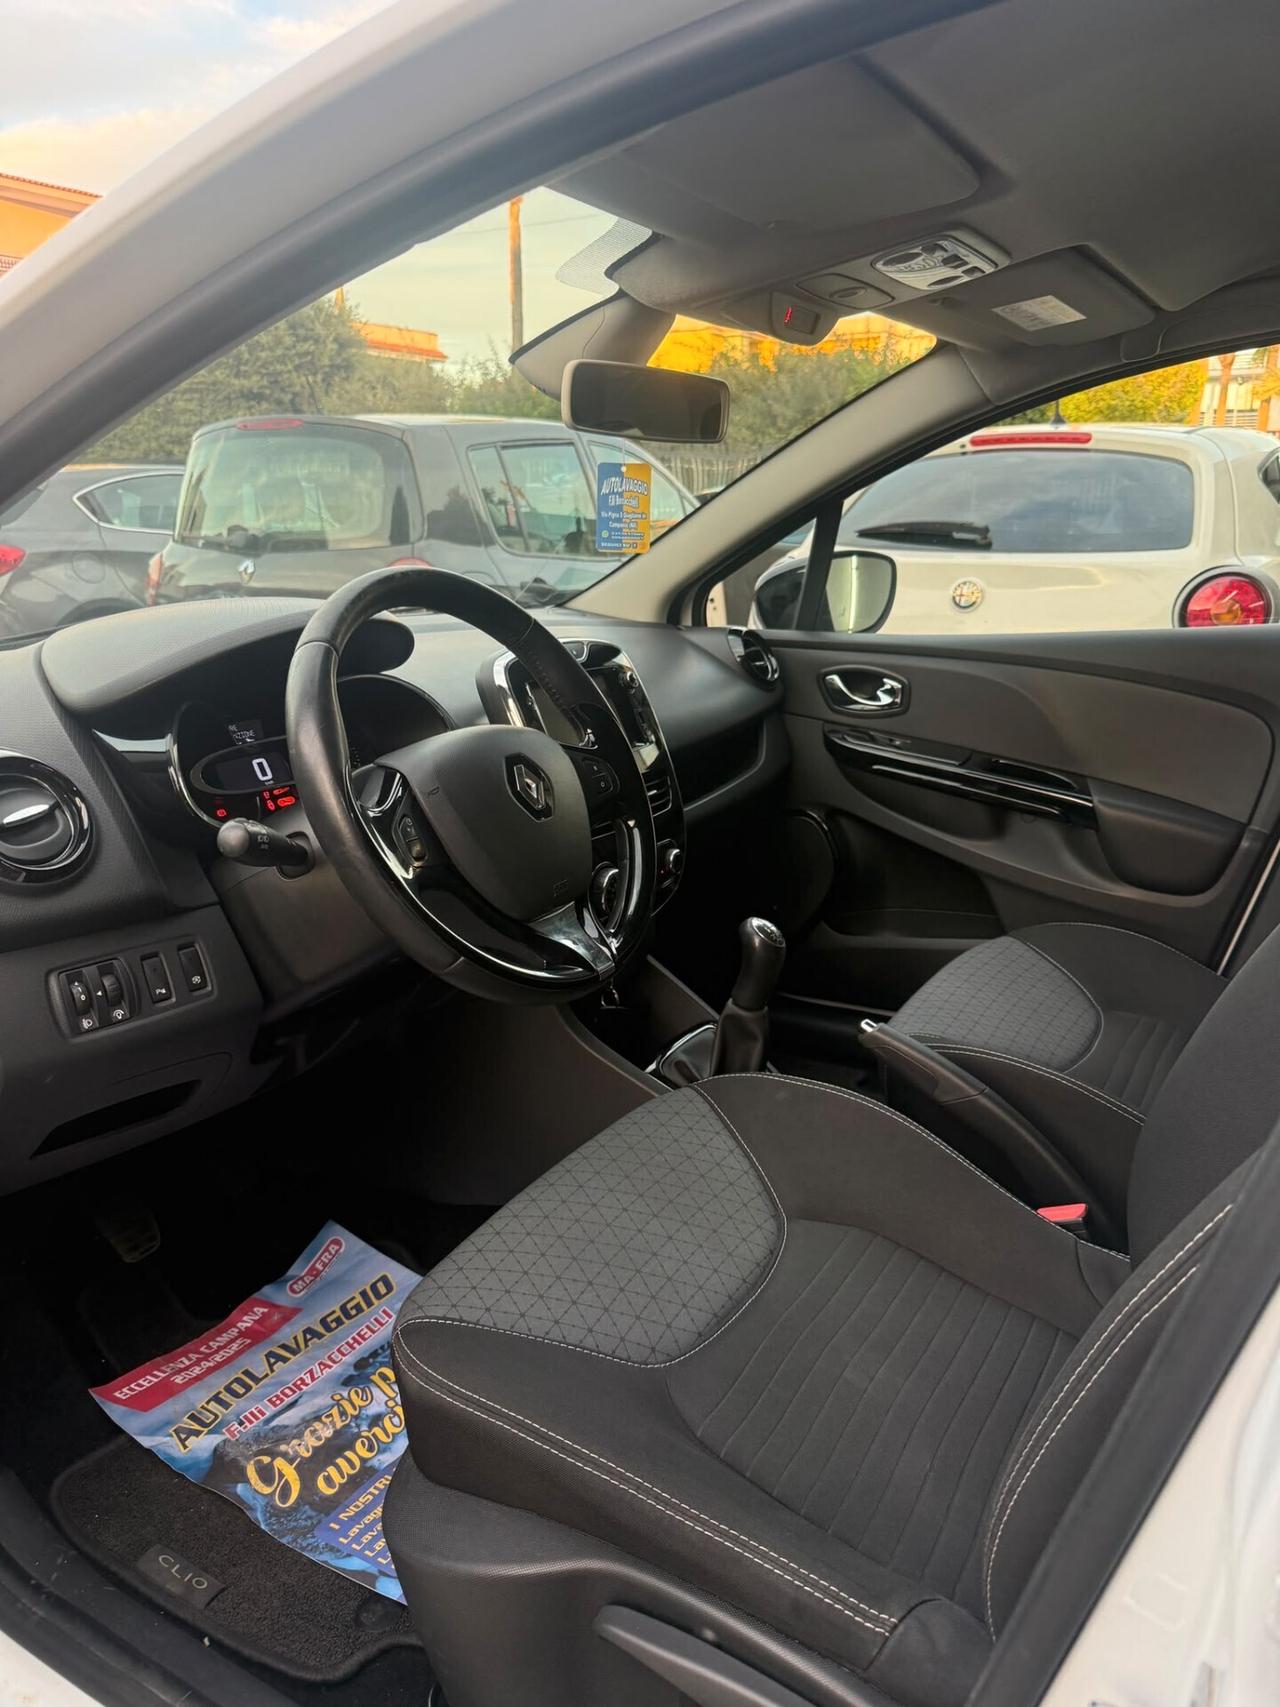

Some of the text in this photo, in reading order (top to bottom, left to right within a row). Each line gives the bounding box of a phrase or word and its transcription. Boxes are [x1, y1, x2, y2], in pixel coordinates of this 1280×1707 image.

[251, 757, 273, 781] 0
[113, 1306, 269, 1400] ECCELLENZA CAMPANA
[170, 1337, 251, 1385] 2024/2025
[170, 1272, 397, 1453] AUTOLAVAGGIO
[223, 1305, 396, 1440] F.lli BORZACCHELLI
[246, 1386, 372, 1508] Grazie
[158, 1554, 208, 1589] CLIO
